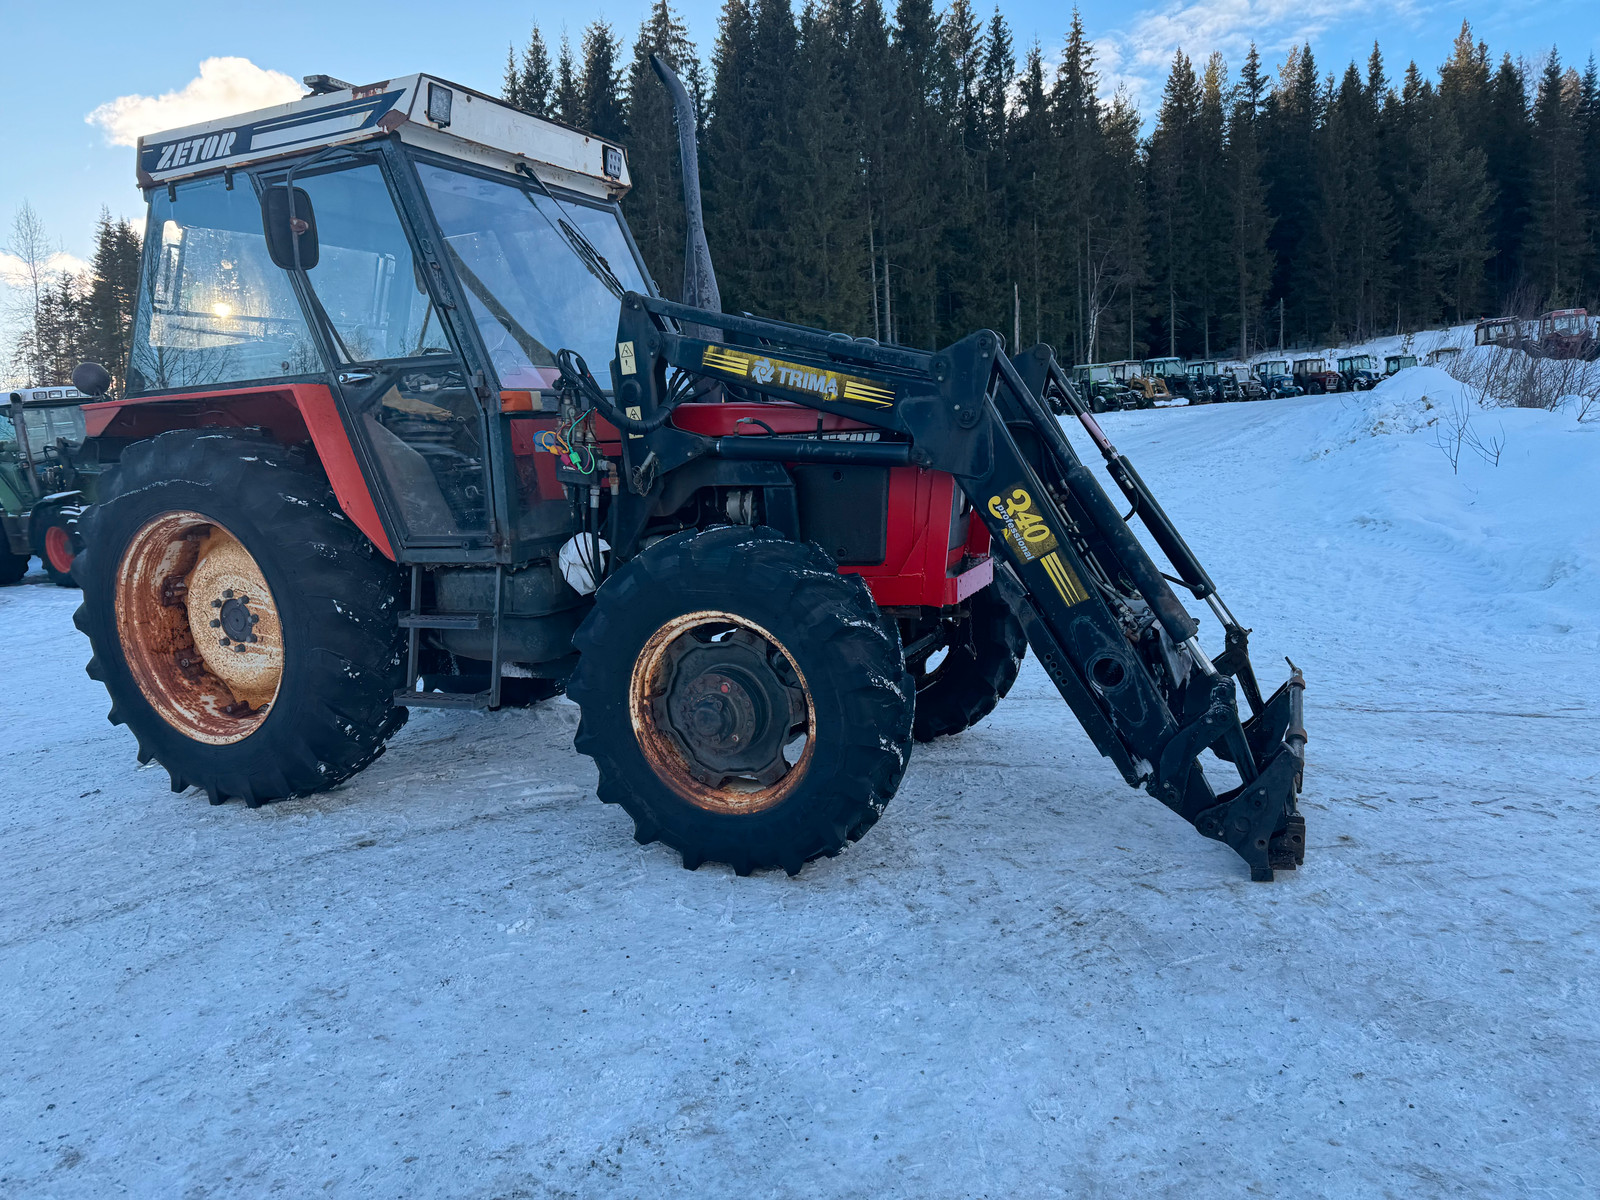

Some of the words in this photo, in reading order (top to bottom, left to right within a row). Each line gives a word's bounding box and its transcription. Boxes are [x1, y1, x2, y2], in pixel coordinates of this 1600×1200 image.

[155, 131, 237, 170] ZETOR
[777, 366, 839, 397] TRIMA
[987, 488, 1051, 543] 340
[995, 504, 1035, 561] professional
